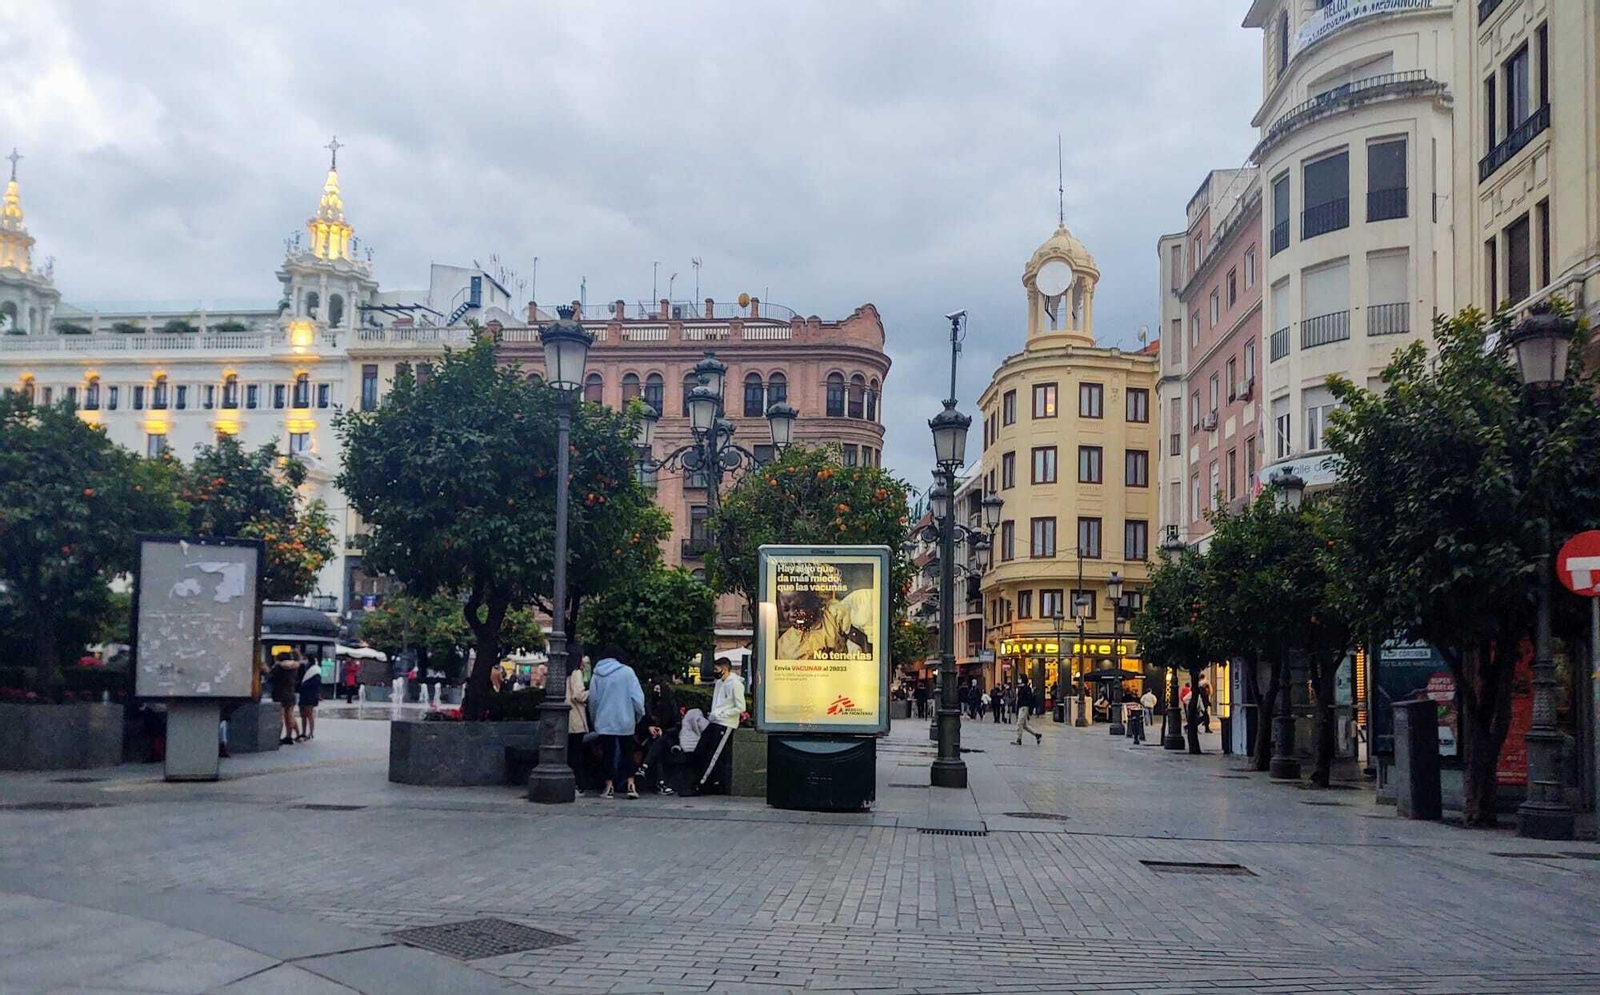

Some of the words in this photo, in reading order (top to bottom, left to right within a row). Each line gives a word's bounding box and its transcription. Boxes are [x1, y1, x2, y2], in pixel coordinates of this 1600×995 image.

[778, 564, 795, 574] Hay
[796, 563, 815, 576] algo
[817, 565, 834, 576] que
[778, 574, 789, 582] da
[790, 574, 809, 582] más
[778, 584, 794, 592] que
[796, 583, 808, 591] las
[813, 650, 828, 660] No
[829, 650, 872, 660] tenerlas
